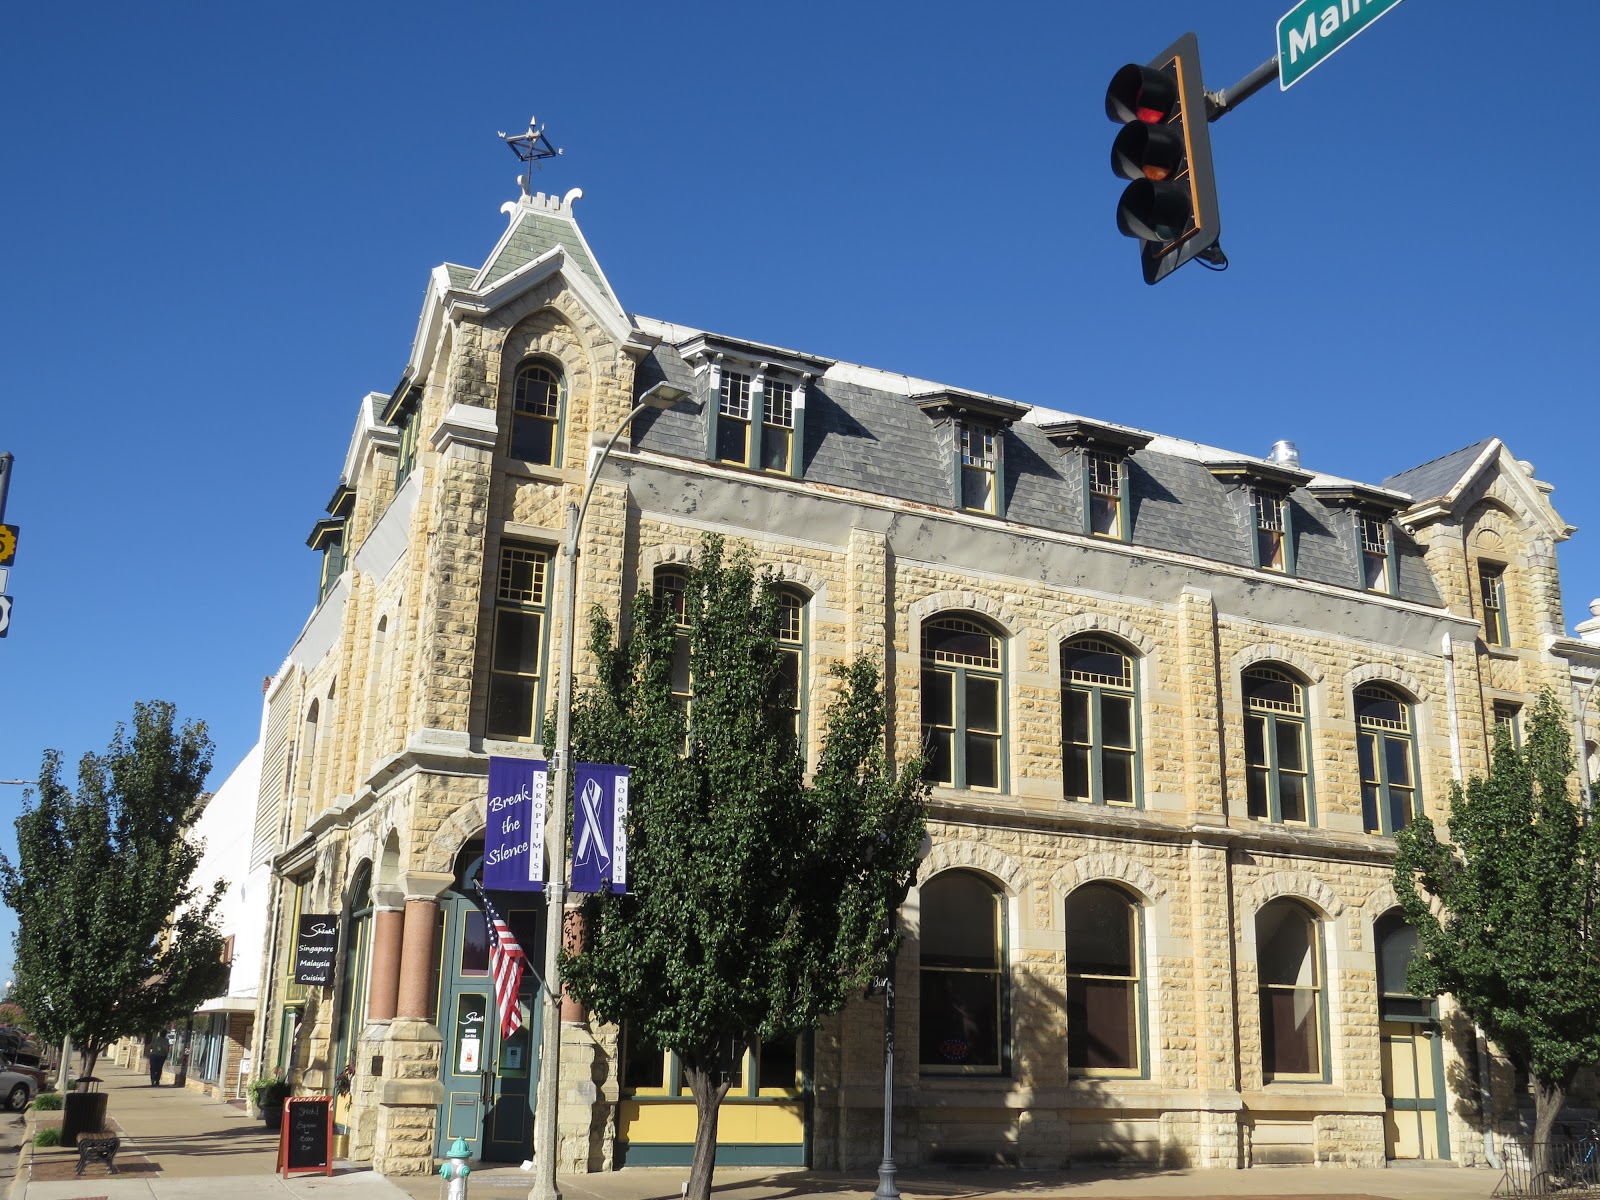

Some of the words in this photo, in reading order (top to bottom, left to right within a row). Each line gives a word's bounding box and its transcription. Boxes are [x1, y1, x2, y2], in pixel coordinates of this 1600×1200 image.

[489, 784, 532, 812] Break
[501, 816, 520, 835] the
[532, 773, 544, 879] SOROPTIMIST
[486, 841, 529, 865] Silence
[299, 944, 334, 954] Singapore
[300, 960, 330, 968] Malaysia
[301, 974, 326, 982] Cuisine
